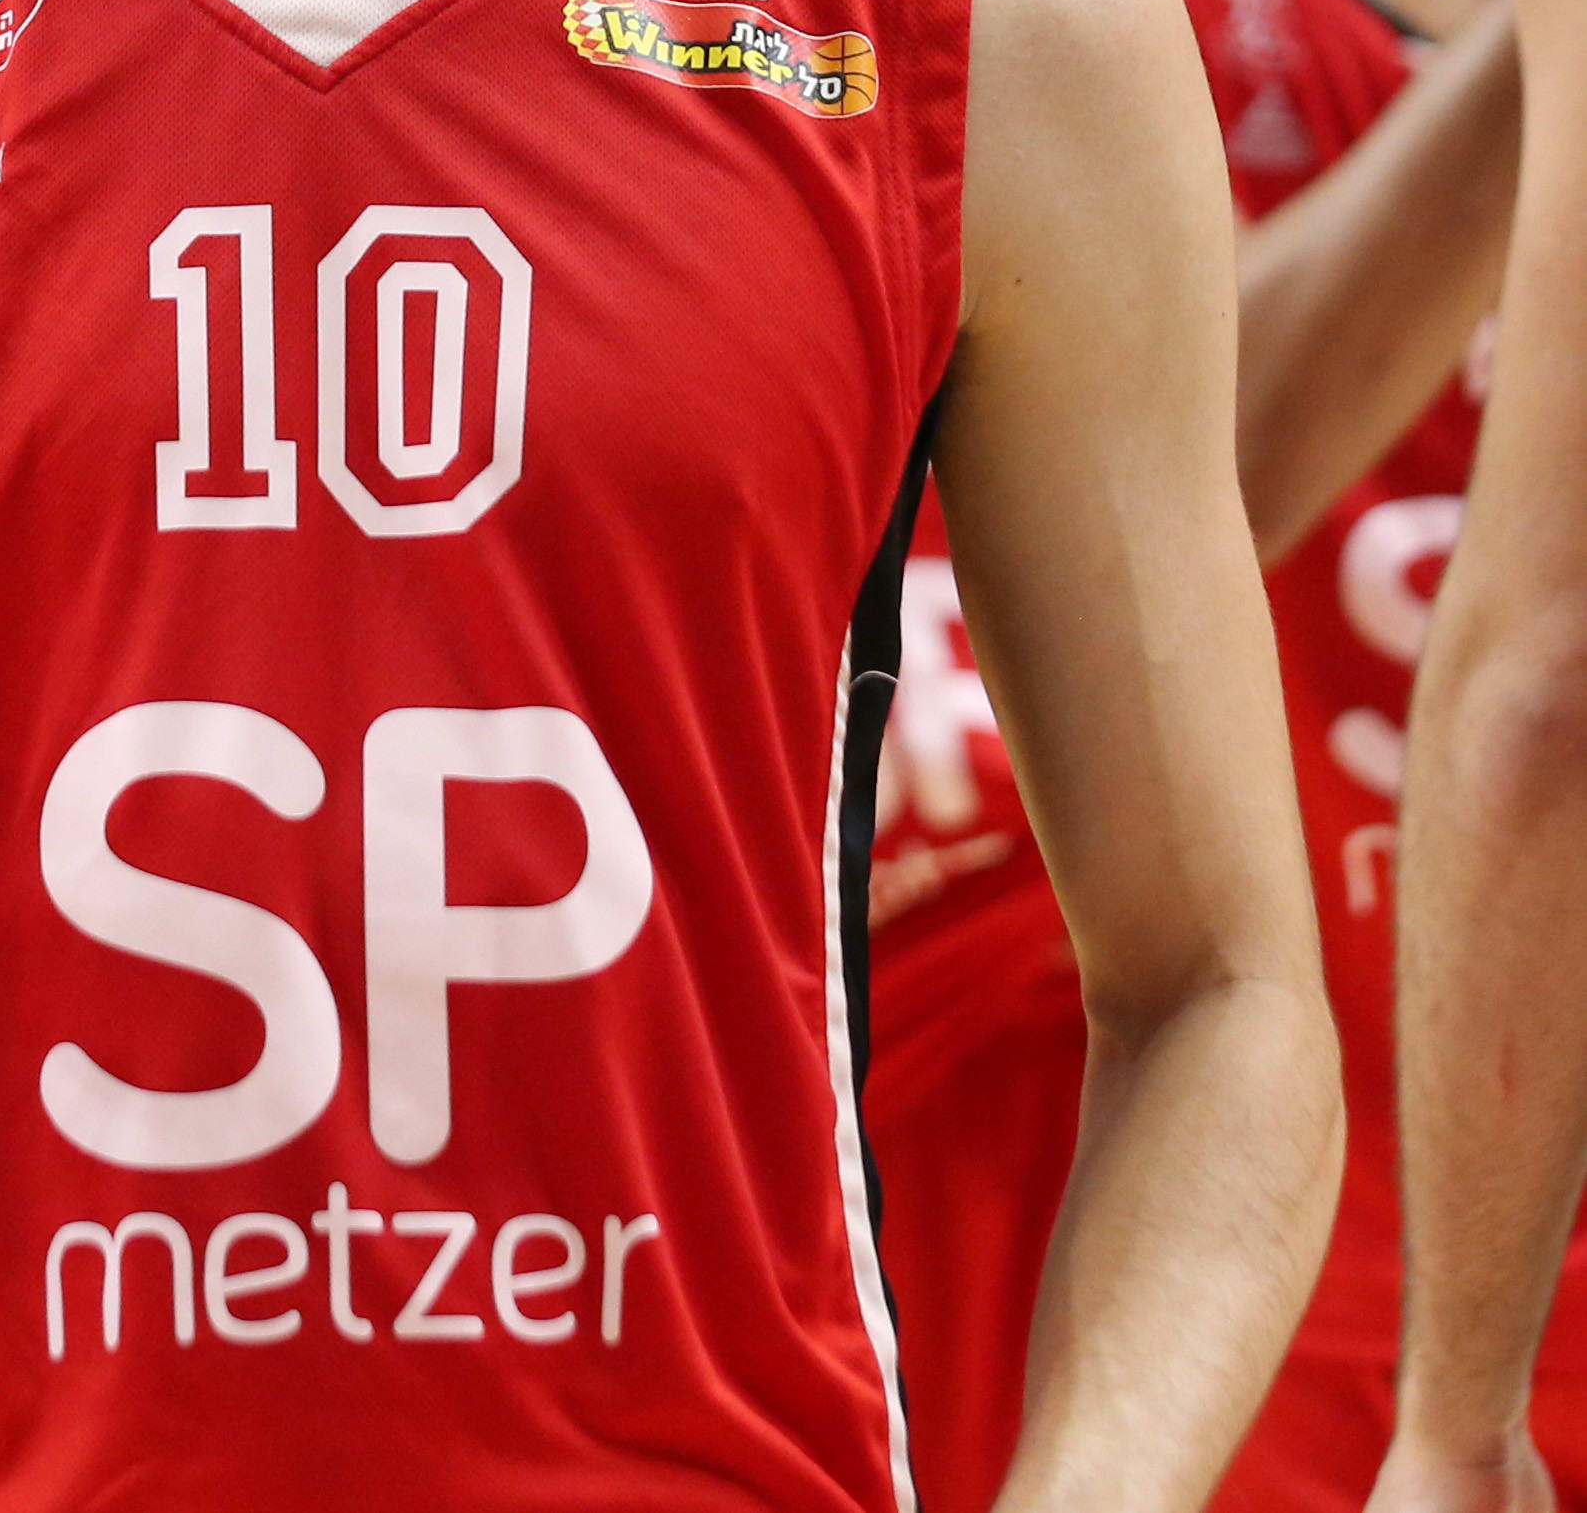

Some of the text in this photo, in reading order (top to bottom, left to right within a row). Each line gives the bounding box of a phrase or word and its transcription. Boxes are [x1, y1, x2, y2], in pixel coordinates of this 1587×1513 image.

[602, 9, 844, 102] Winner סל
[731, 22, 790, 61] ליגת
[149, 204, 532, 538] 10
[39, 699, 654, 1172] SP
[45, 1180, 660, 1363] metzer
